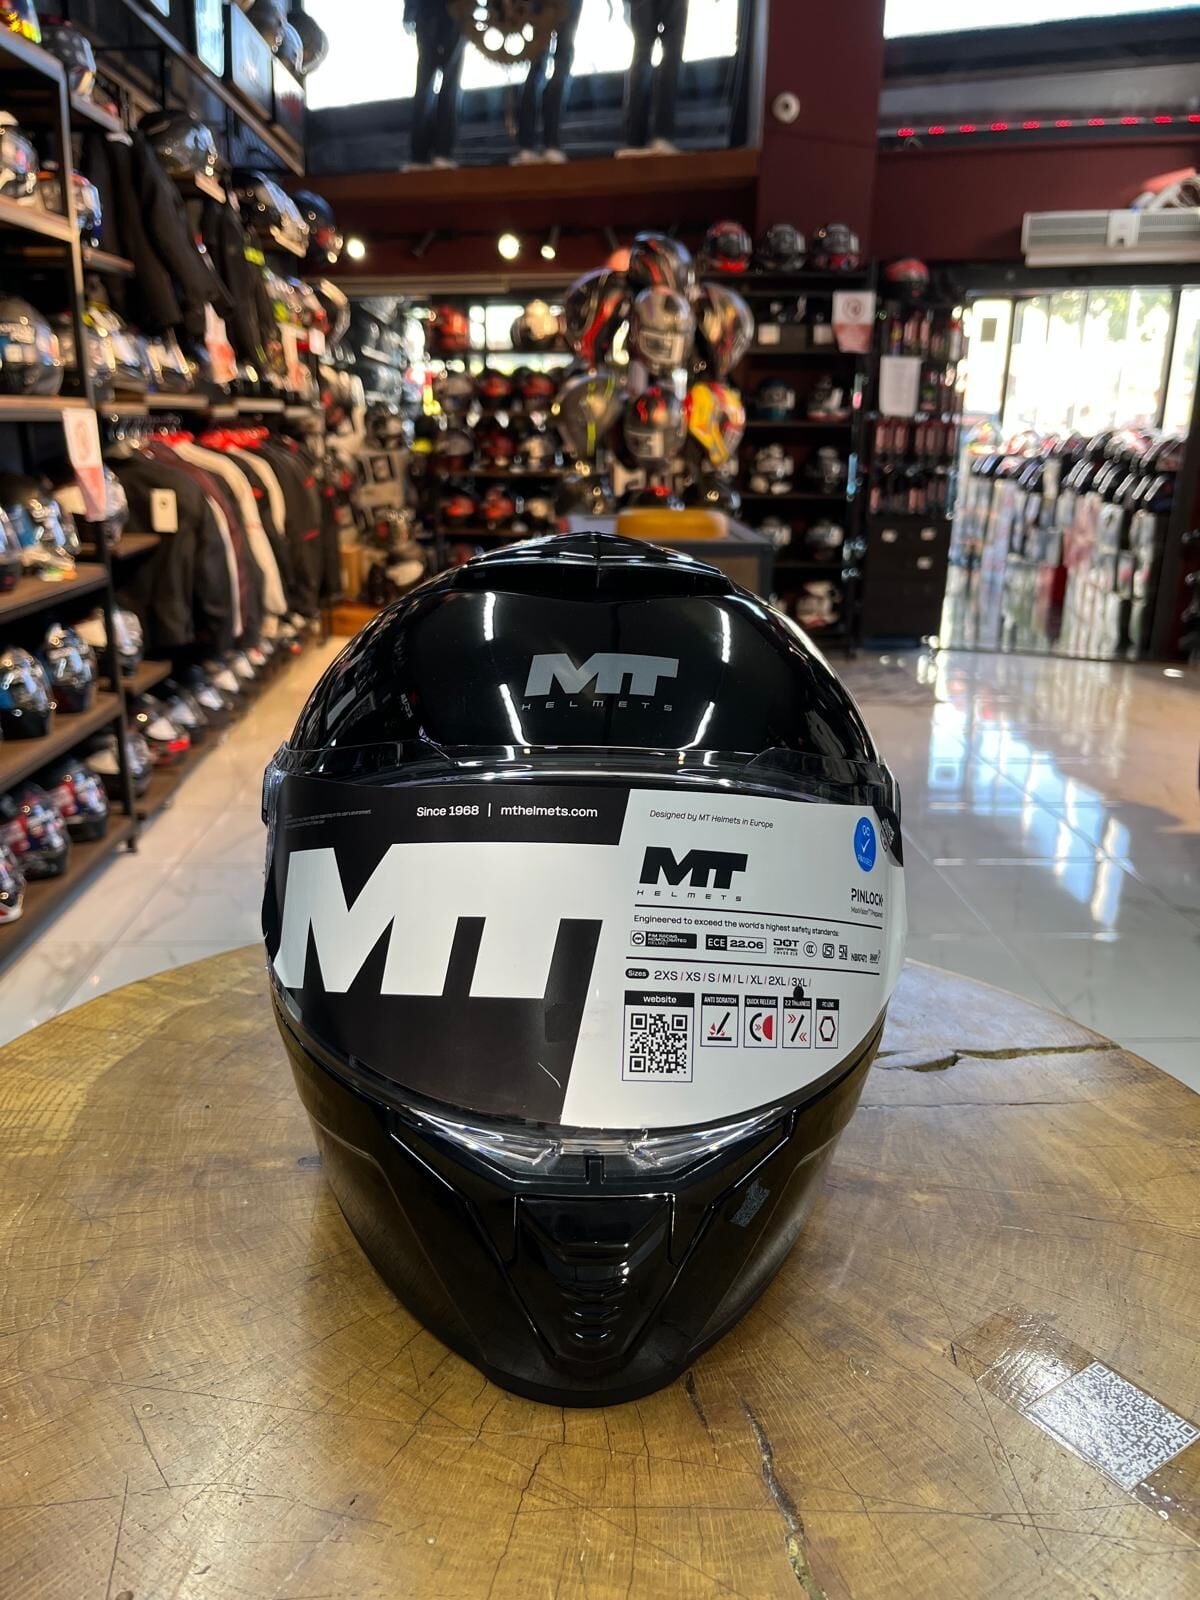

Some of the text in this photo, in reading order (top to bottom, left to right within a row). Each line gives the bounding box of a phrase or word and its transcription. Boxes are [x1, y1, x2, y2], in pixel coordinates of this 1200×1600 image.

[524, 653, 680, 697] MT
[521, 700, 673, 711] HELMETS
[416, 805, 598, 817] Since 1968 mthelmets.com
[649, 810, 686, 820] Designed
[687, 812, 697, 821] by
[711, 815, 741, 825] Helmets
[749, 819, 774, 829] Europe
[639, 846, 748, 889] MT
[637, 890, 742, 902] HELMETS
[273, 842, 619, 998] MT
[634, 915, 682, 924] Engineered
[694, 918, 723, 926] exceed
[724, 920, 737, 928] the
[738, 922, 765, 930] world's
[765, 923, 790, 932] highest
[791, 925, 811, 935] safety
[707, 938, 764, 949] ECE 22.06
[773, 938, 800, 947] DOT
[654, 970, 808, 987] 2XS XS S M L XL 2XL 3XL
[643, 995, 677, 1004] website
